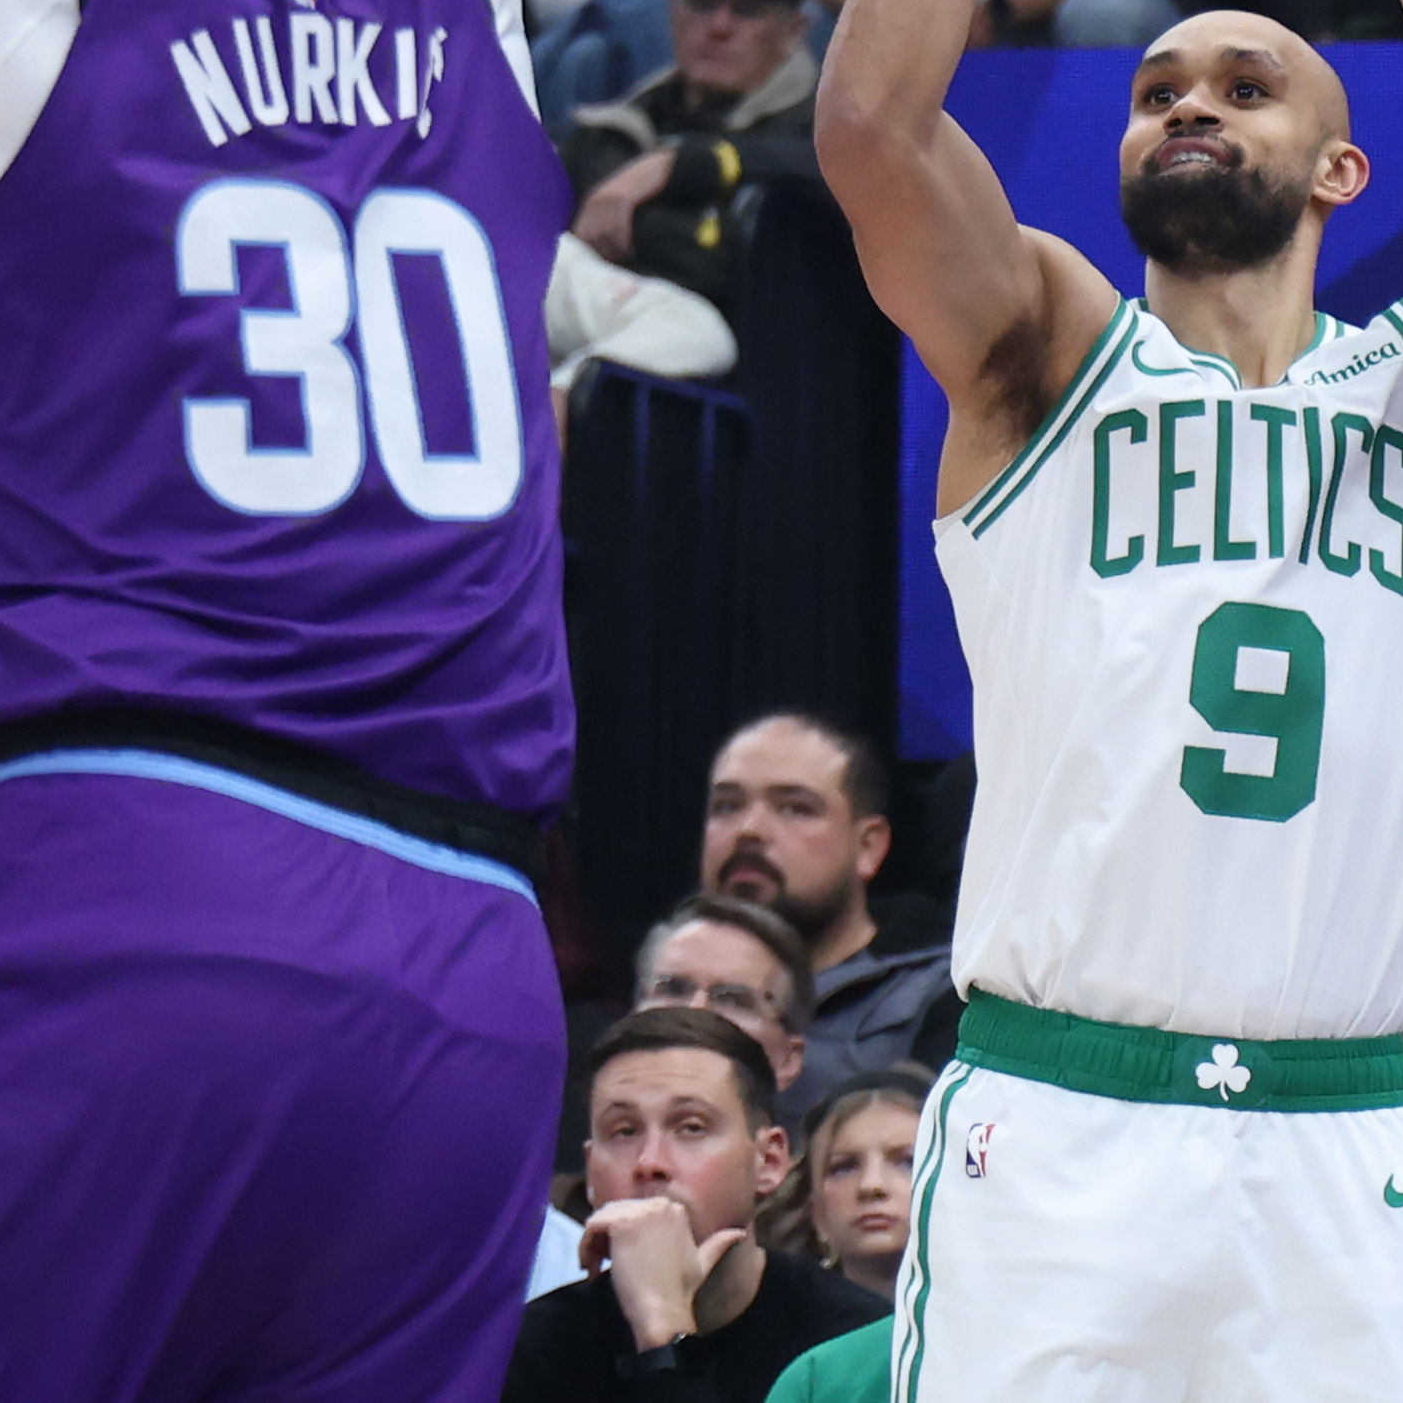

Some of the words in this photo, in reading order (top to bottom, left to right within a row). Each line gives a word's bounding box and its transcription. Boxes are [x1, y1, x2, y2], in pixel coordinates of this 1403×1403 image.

[175, 176, 525, 522] 30
[1303, 342, 1401, 386] Amica
[1179, 601, 1326, 823] 9
